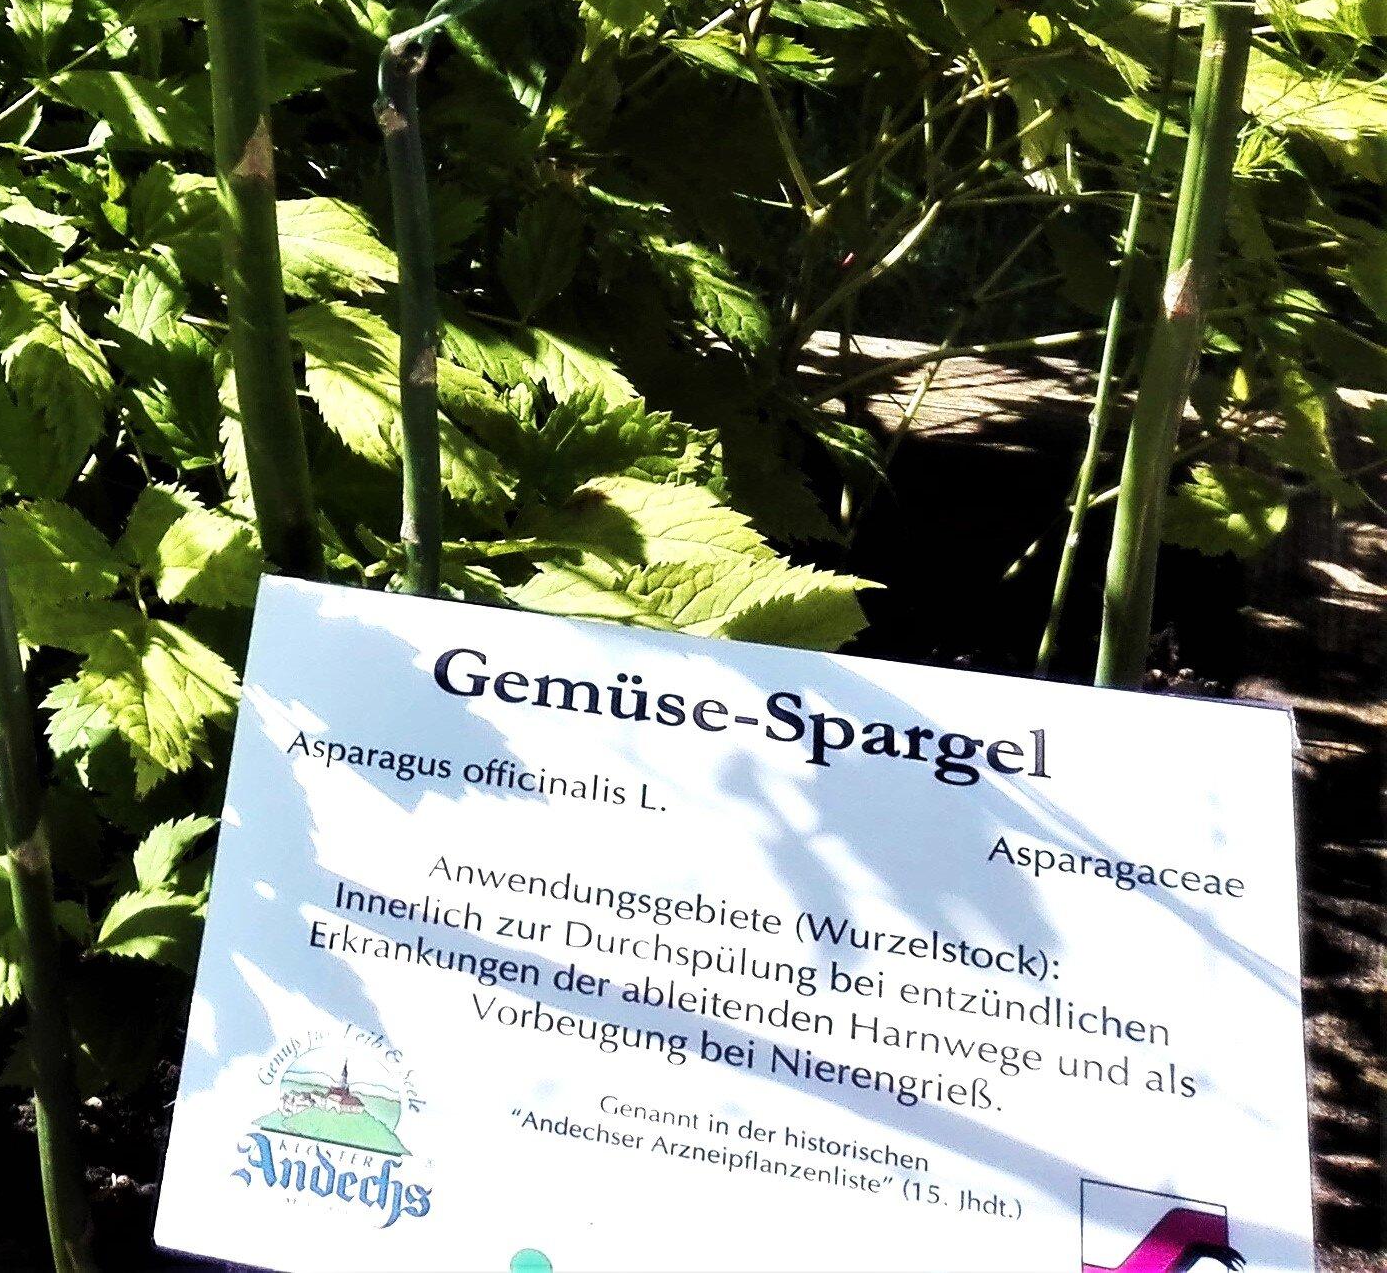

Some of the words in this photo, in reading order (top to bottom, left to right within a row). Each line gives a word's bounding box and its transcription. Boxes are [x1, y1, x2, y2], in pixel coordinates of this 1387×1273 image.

[286, 730, 452, 782] Asparagus
[463, 757, 627, 805] officinalis
[640, 783, 668, 812] L.
[433, 648, 1053, 786] Gemüse-Spargel
[428, 855, 783, 935] Anwendungsgebiete
[795, 911, 1060, 982] (Wurzelstock):
[988, 836, 1246, 898] Asparagaceae
[309, 920, 540, 987] Erkrankungen
[553, 963, 611, 997] der
[621, 976, 834, 1036] ableitenden
[850, 1013, 1043, 1077] Harnwege
[1059, 1055, 1130, 1087] und
[1145, 1063, 1197, 1098] als
[334, 881, 483, 932] Innerlich
[496, 916, 552, 942] zur
[565, 920, 818, 997] Durchspülung
[830, 960, 885, 999] bei
[900, 982, 1170, 1046] entzündlichen
[472, 993, 689, 1066] Vorbeugung
[700, 1029, 755, 1069] bei
[770, 1044, 1003, 1112] Nierengrieß.
[230, 1132, 433, 1229] Andechs
[600, 1095, 699, 1130] Genannt
[709, 1114, 729, 1135] in
[738, 1120, 776, 1144] der
[785, 1126, 929, 1172] historischen
[903, 1178, 948, 1206] (15.
[958, 1190, 1023, 1221] Jhdt.)
